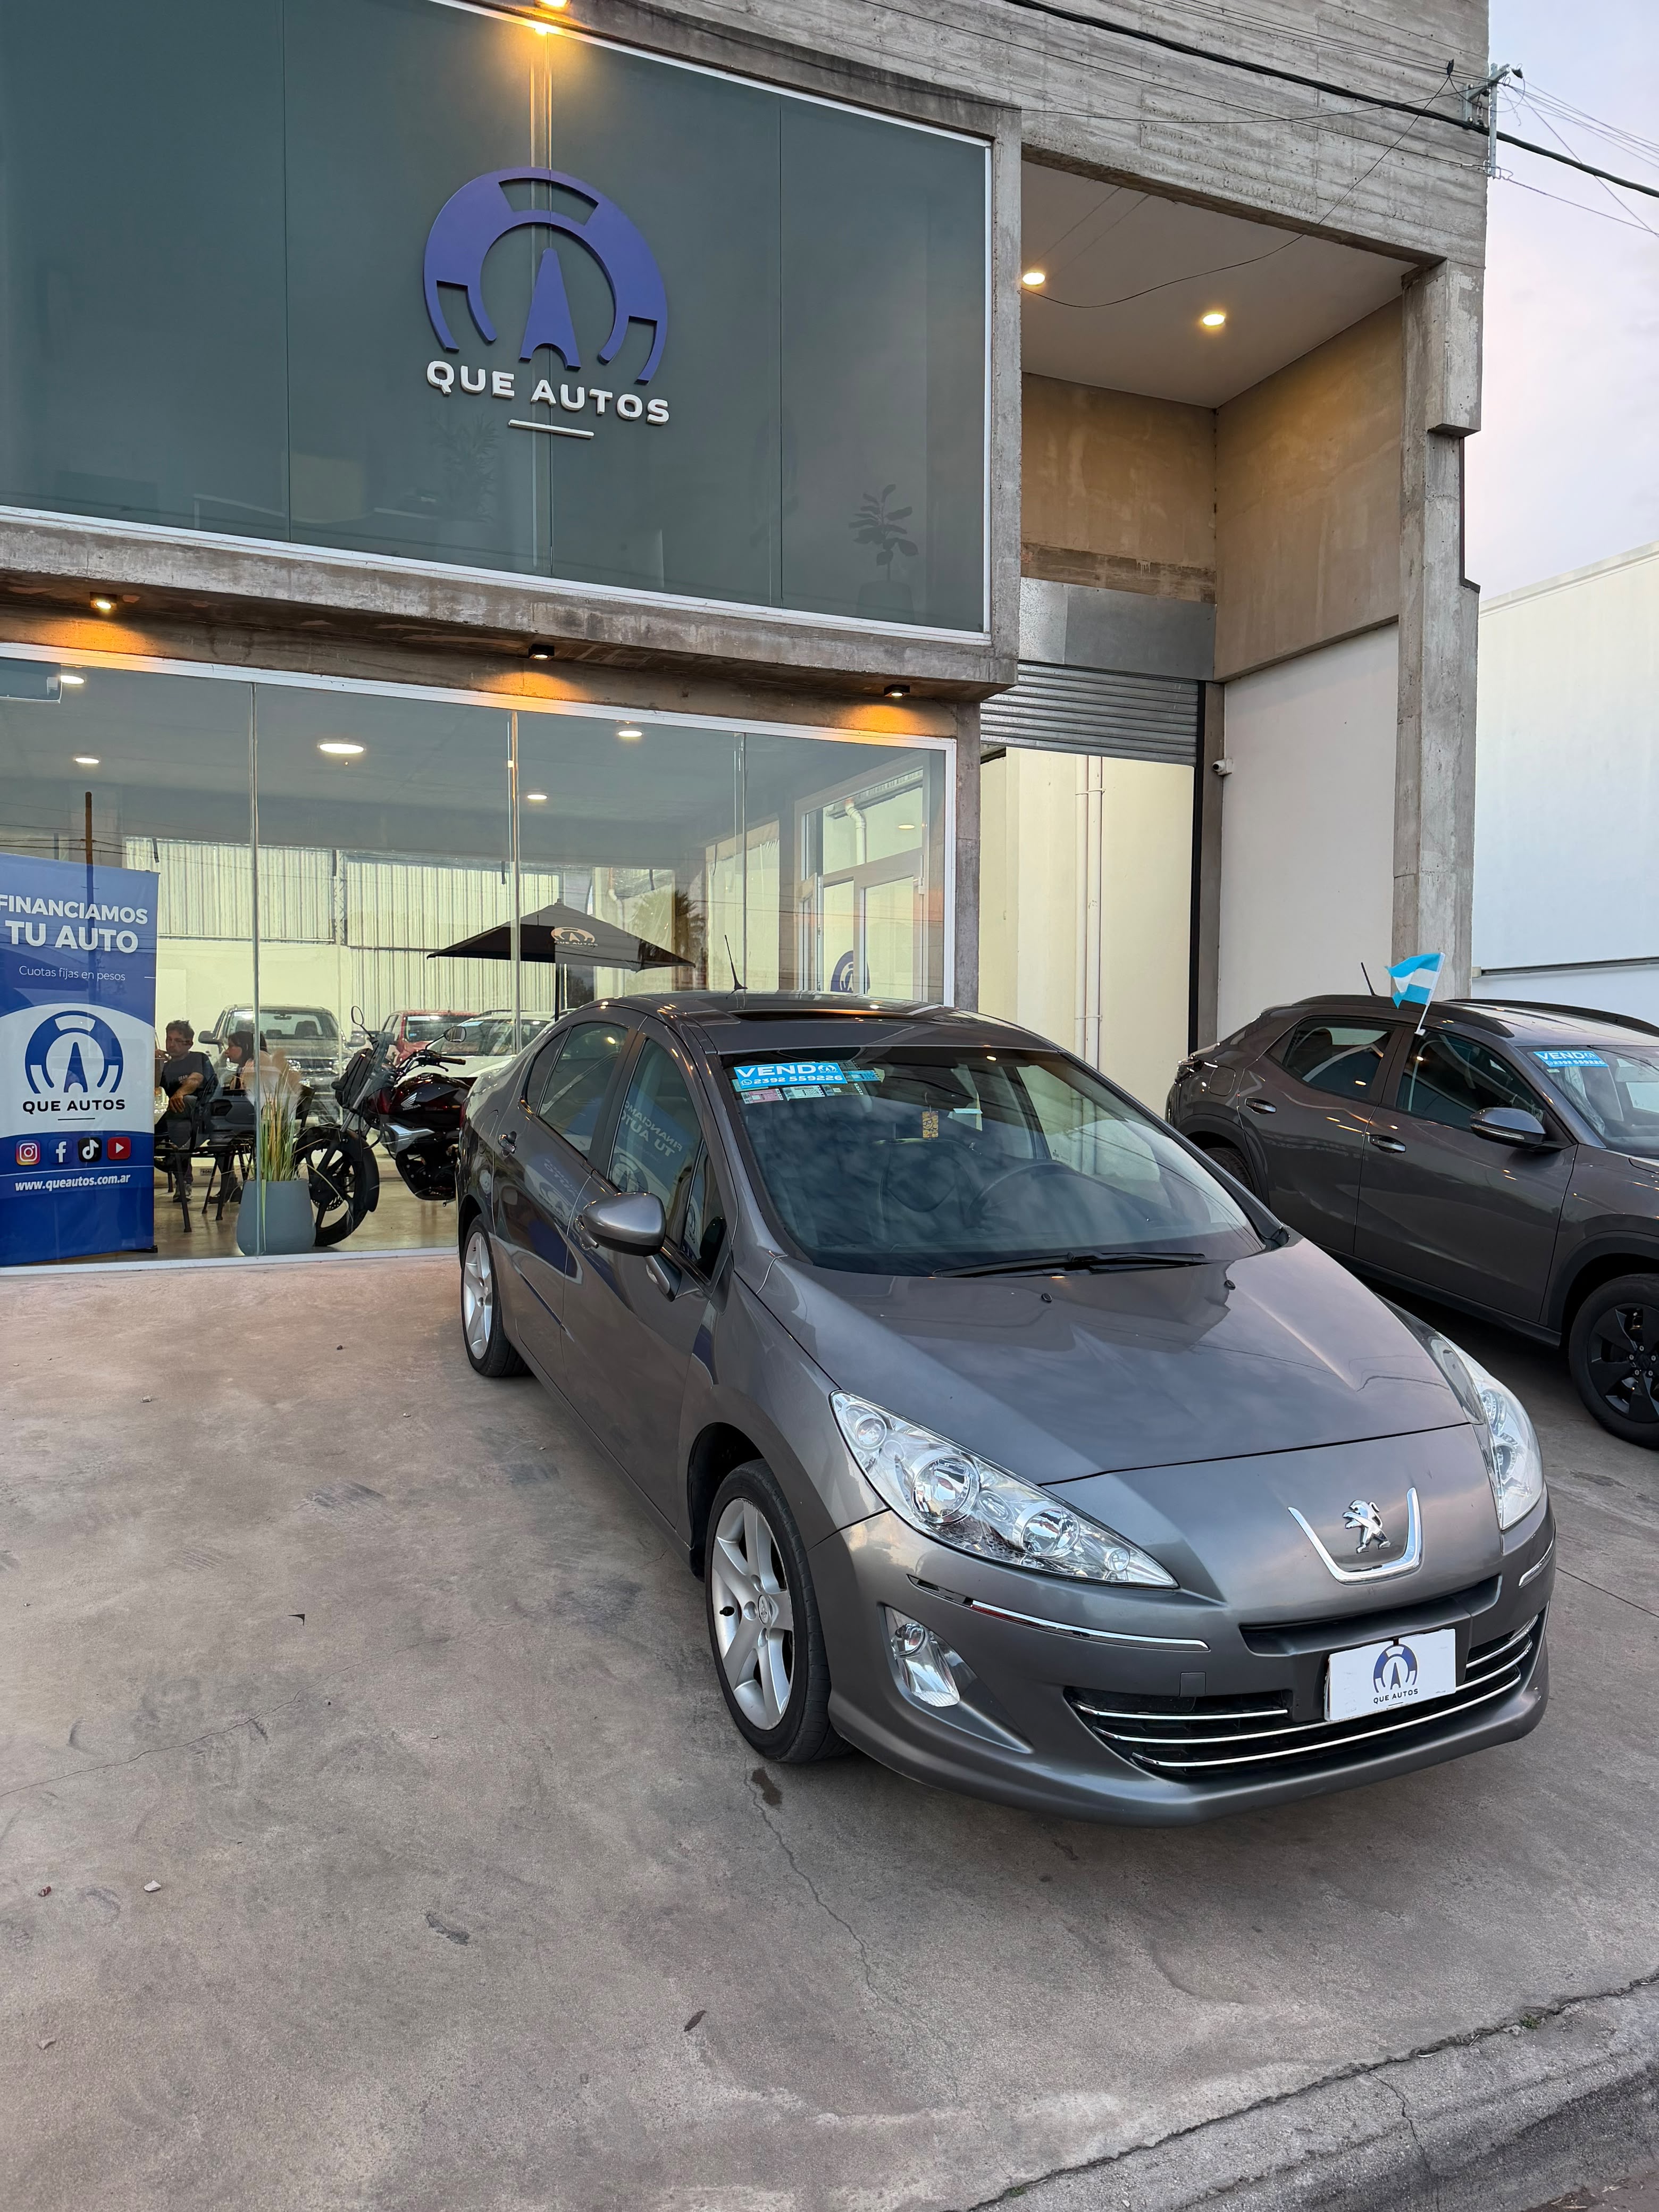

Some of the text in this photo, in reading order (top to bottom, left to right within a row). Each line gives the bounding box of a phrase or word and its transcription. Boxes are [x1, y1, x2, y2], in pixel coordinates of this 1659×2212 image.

[426, 360, 670, 425] QUE AUTOS
[0, 894, 148, 925] FINANCIAMOS
[5, 920, 139, 953] TU AUTO
[19, 966, 56, 977] Cuotas
[58, 968, 79, 979] fijas
[96, 972, 126, 982] pesos
[22, 1099, 125, 1115] QUE AUTOS
[15, 1174, 130, 1192] www.queautos.com.ar
[1373, 1688, 1419, 1704] QUE AUTOS
